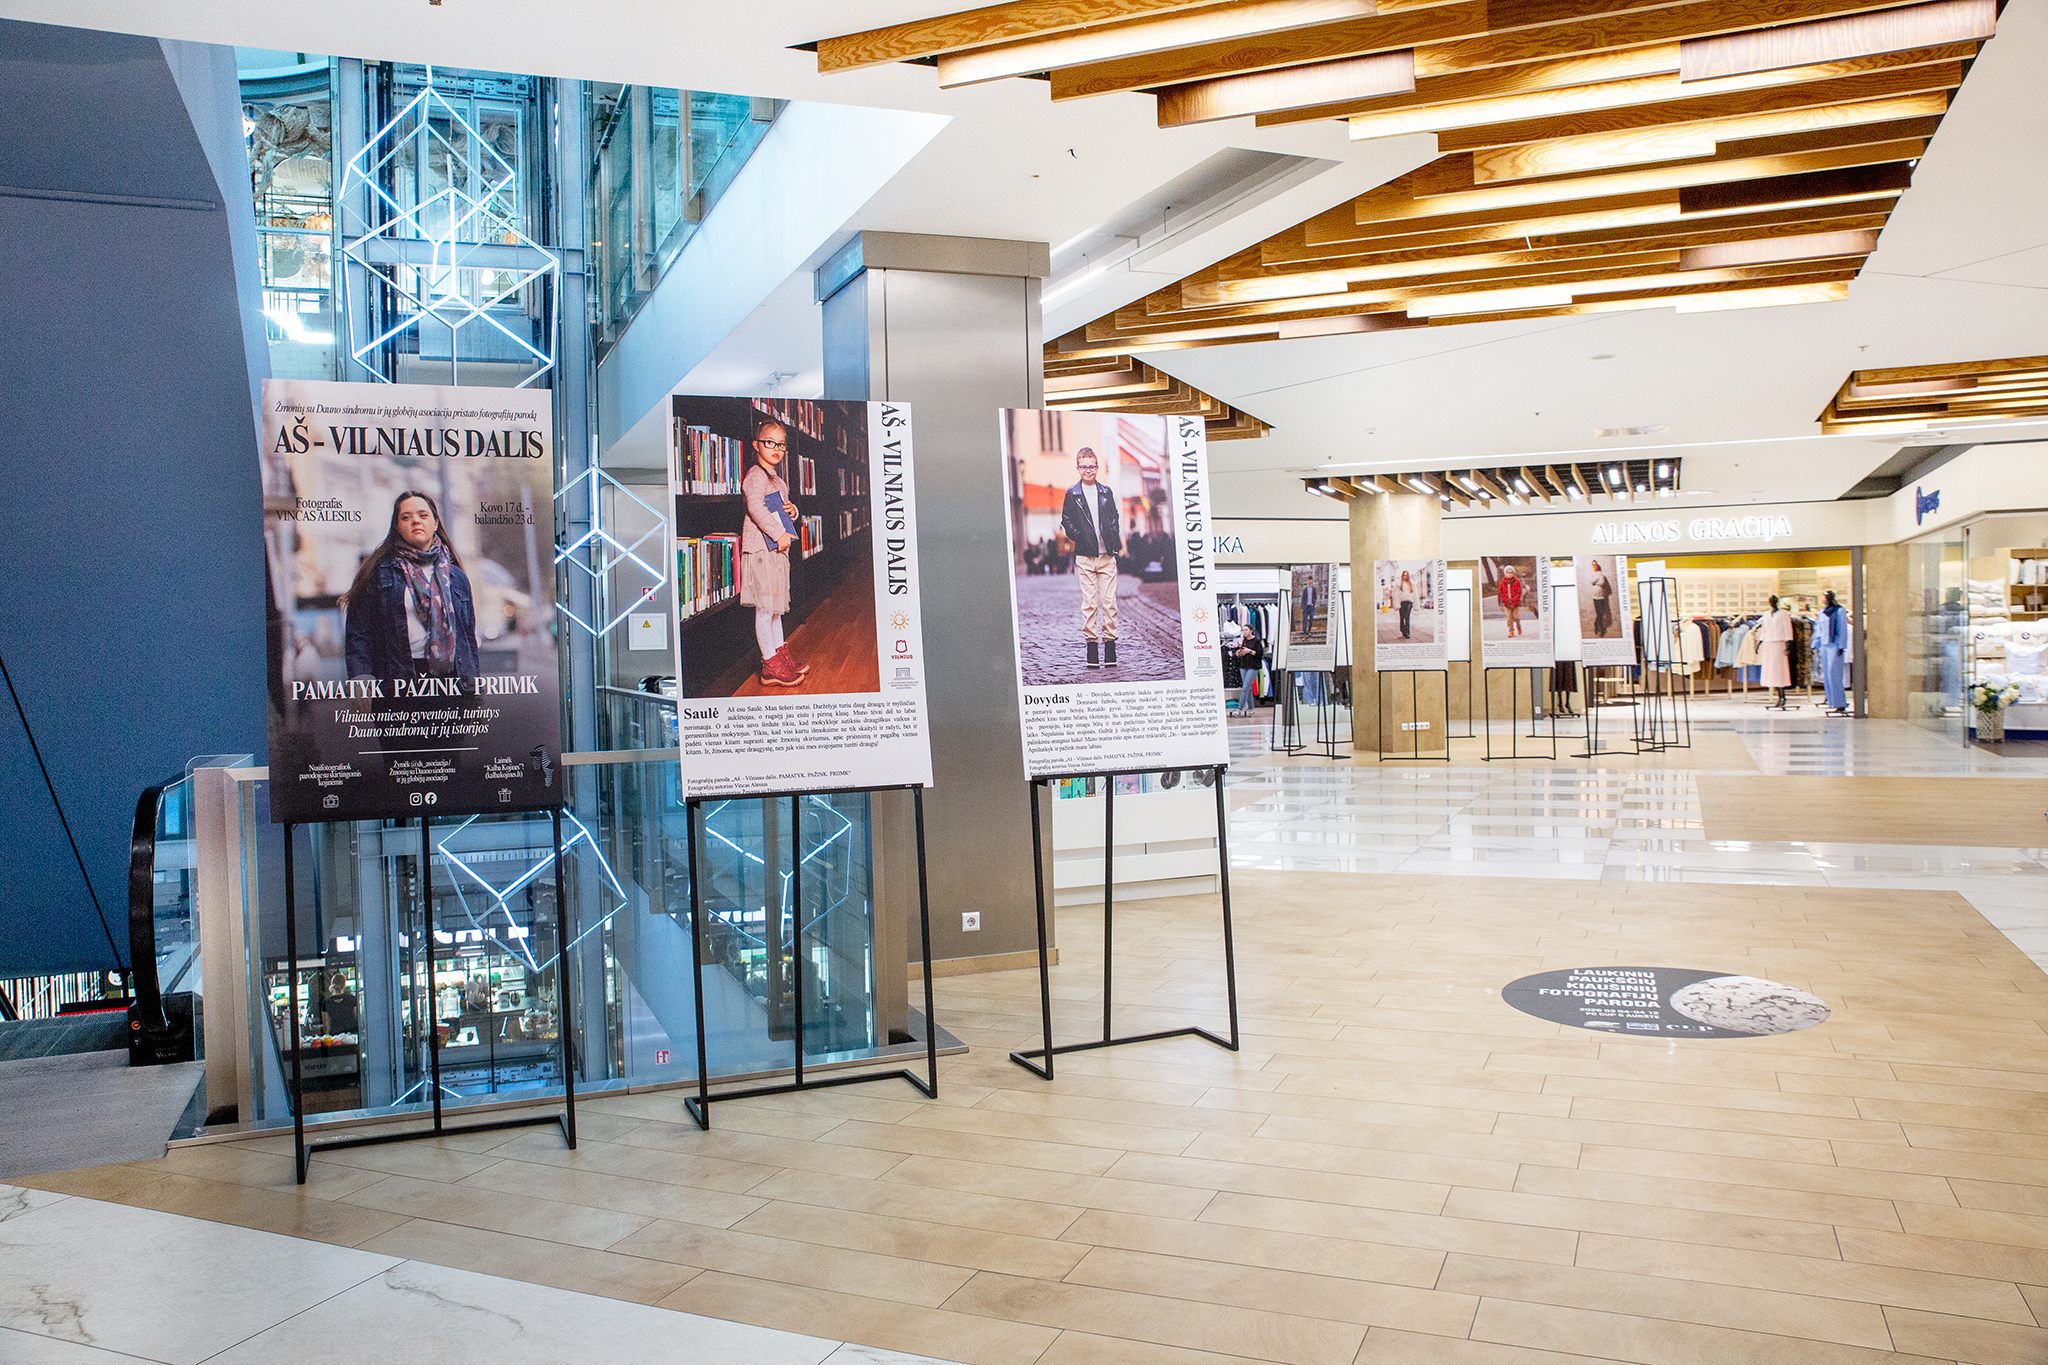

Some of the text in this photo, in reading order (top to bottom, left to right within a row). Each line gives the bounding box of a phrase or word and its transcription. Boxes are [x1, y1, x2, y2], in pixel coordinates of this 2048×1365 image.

[275, 400, 305, 416] Žmonių
[316, 404, 341, 414] Dauno
[342, 405, 376, 415] sindromu
[377, 406, 382, 415] ir
[382, 406, 392, 417] jų
[392, 406, 418, 418] globėjų
[418, 408, 452, 419] asociacija
[452, 408, 478, 419] pristato
[477, 408, 514, 420] fotografijų
[514, 410, 537, 421] parodą
[881, 403, 906, 427] AŠ
[1179, 416, 1200, 438] AŠ
[274, 415, 310, 454] AŠ
[328, 426, 460, 457] VILNIAUS
[464, 429, 544, 458] DALIS
[883, 440, 905, 530] VILNIAUS
[1182, 450, 1203, 533] VILNIAUS
[296, 497, 343, 511] Fotografas
[480, 502, 503, 513] Kovo
[506, 502, 515, 512] 17
[516, 502, 524, 513] d.
[276, 510, 362, 522] VINCAS ALESIUS
[474, 514, 535, 525] balandžio 23 d.
[1592, 516, 1792, 544] ALINOS GRACIJA
[886, 537, 908, 595] DALIS
[1186, 539, 1207, 591] DALIS
[291, 672, 539, 700] PAMATYK PAŽINK PRIIMK
[1024, 694, 1070, 707] Dovydas
[334, 707, 500, 724] Vilniaus miesto gyventojai, turintys
[683, 708, 719, 720] Saulė
[348, 722, 489, 738] Dauno sindromą ir jų istorijos
[1568, 975, 1656, 986] PAUKŠČIŲ
[1574, 969, 1654, 979] LAUKINIŲ
[1539, 988, 1659, 1001] FOTOGRAFIJŲ
[1566, 982, 1657, 993] KIAUŠINIŲ
[1584, 998, 1661, 1008] PARODA
